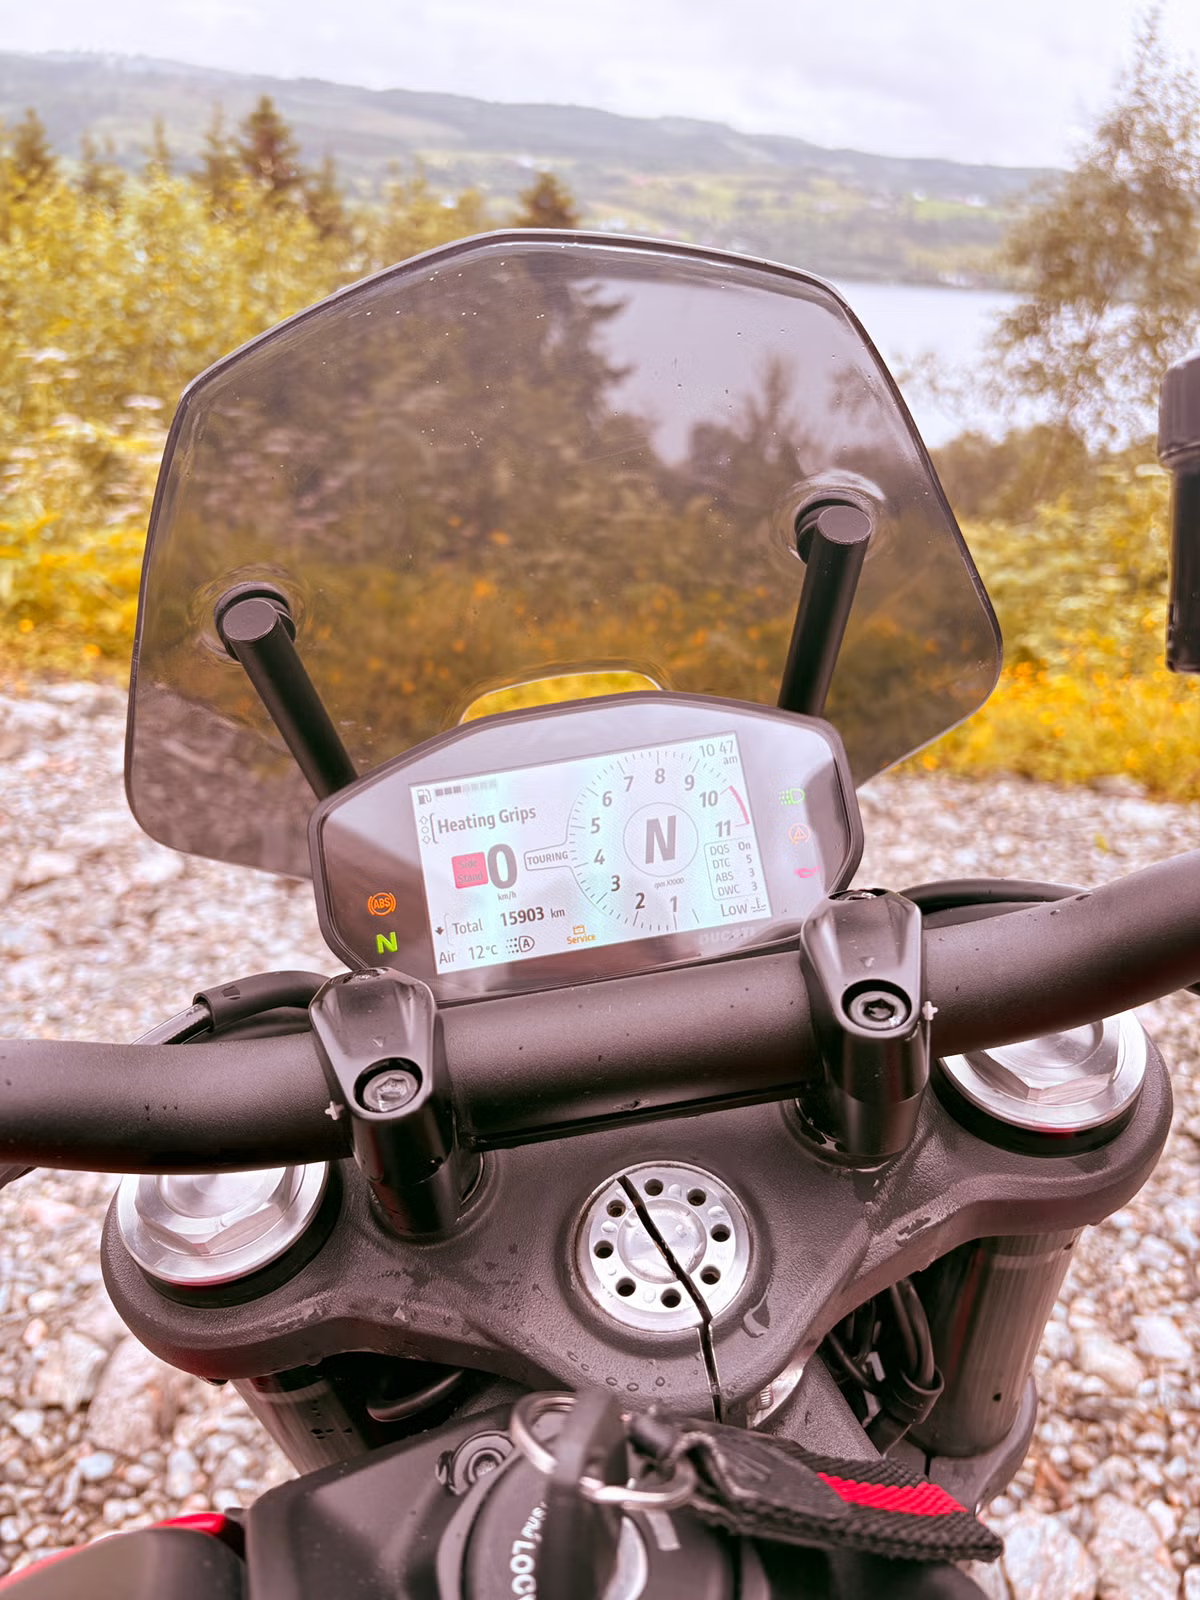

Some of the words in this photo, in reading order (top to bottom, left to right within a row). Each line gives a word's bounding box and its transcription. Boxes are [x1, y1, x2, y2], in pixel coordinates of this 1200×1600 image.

[699, 743, 715, 758] 10
[719, 740, 734, 755] 47
[723, 756, 738, 765] am
[623, 776, 634, 792] 7
[654, 768, 665, 784] 8
[684, 775, 695, 791] 9
[602, 790, 612, 807] 6
[699, 790, 718, 808] 10
[437, 813, 496, 834] Heating
[499, 807, 536, 825] Grips
[590, 817, 601, 834] 5
[715, 820, 731, 838] 11
[645, 815, 676, 865] N
[709, 843, 730, 856] DQS
[738, 841, 751, 851] On
[457, 859, 478, 870] Side
[526, 850, 569, 866] TOURING
[594, 849, 605, 865] 4
[713, 858, 731, 869] DTC
[746, 854, 752, 864] 5
[487, 843, 518, 889] 0
[457, 870, 483, 885] Stand
[716, 871, 734, 883] ABS
[749, 867, 755, 877] 3
[610, 875, 621, 892] 3
[718, 884, 741, 897] DWC
[752, 881, 758, 891] 3
[372, 895, 391, 911] ABS
[497, 890, 517, 901] km/h
[635, 892, 645, 909] 2
[669, 896, 678, 912] 1
[720, 903, 748, 917] Low
[452, 917, 483, 935] Total
[500, 906, 545, 927] 15903
[550, 907, 566, 919] km
[376, 931, 398, 954] N
[566, 932, 596, 945] Service
[440, 950, 456, 965] Air
[510, 1540, 537, 1600] LOC
